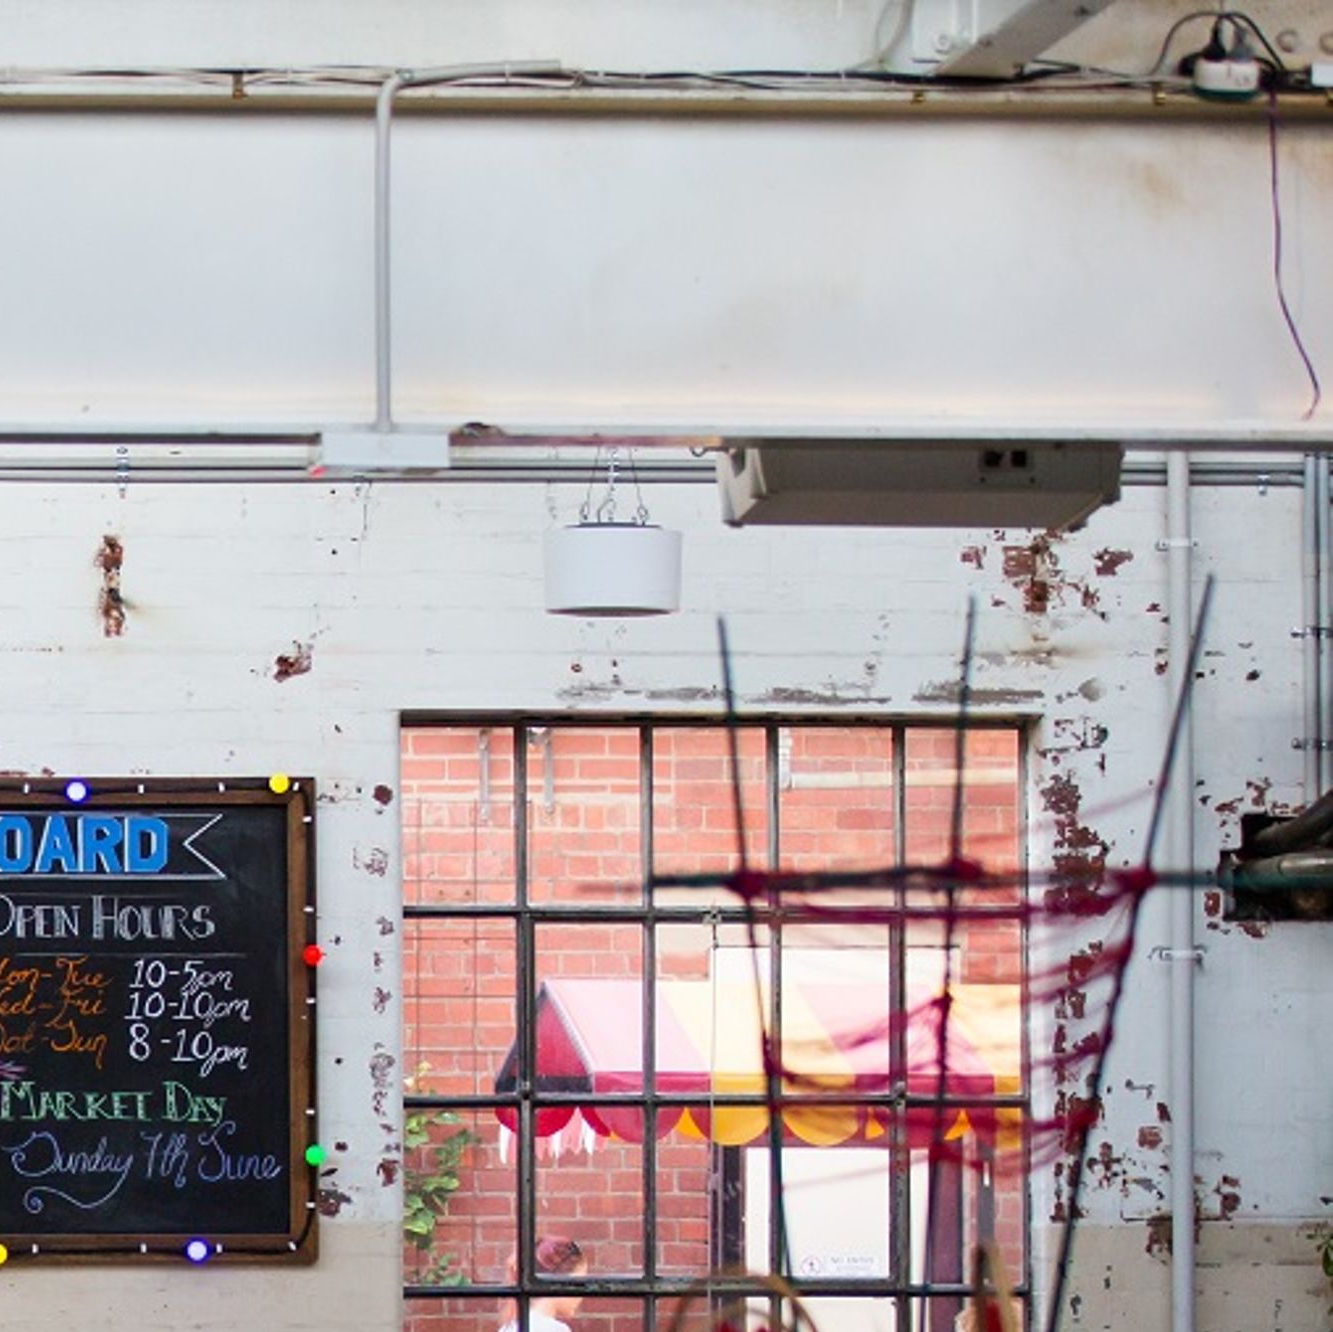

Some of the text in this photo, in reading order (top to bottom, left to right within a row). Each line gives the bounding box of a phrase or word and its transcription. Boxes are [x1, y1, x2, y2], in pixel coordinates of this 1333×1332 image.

[91, 895, 216, 940] HOURS
[128, 959, 234, 995] 10-5pm
[124, 990, 251, 1028] 10-10pm
